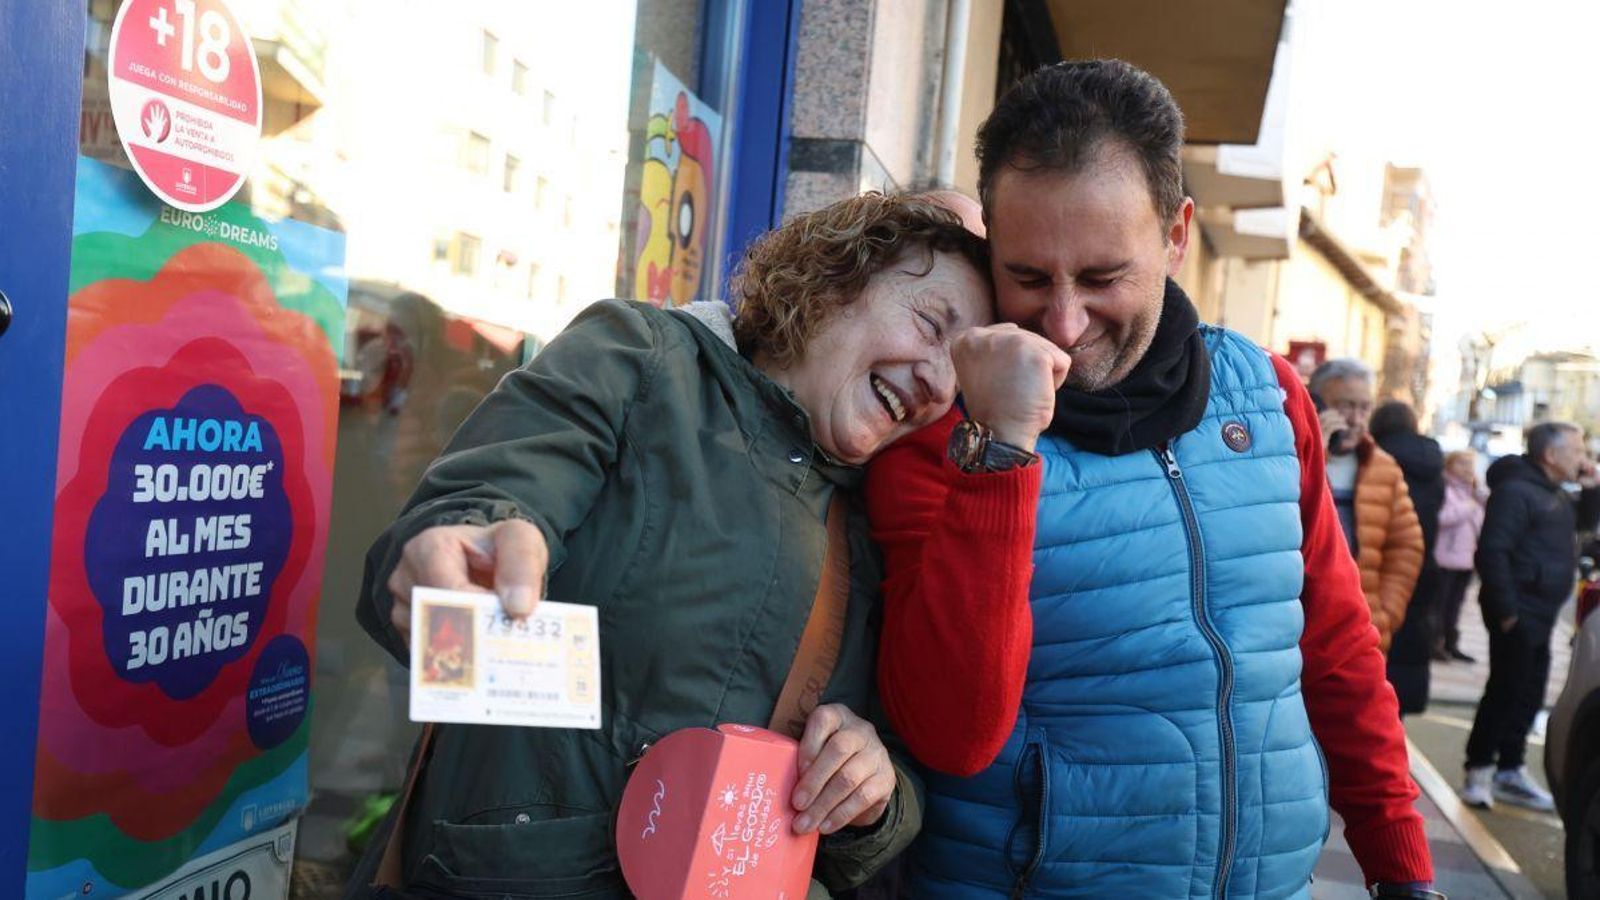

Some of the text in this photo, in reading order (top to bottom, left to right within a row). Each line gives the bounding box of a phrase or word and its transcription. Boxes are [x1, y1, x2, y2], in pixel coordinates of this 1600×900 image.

[149, 0, 231, 83] +18
[128, 62, 248, 112] JUEGA CON RESPONSABILIDAD
[175, 110, 213, 131] PROHIBIDA
[220, 221, 278, 252] DREAMS
[143, 417, 263, 453] AHORA
[145, 513, 252, 558] AL MES
[122, 561, 264, 617] DURANTE
[126, 608, 250, 671] 30 AÑOS
[732, 845, 750, 876] EL
